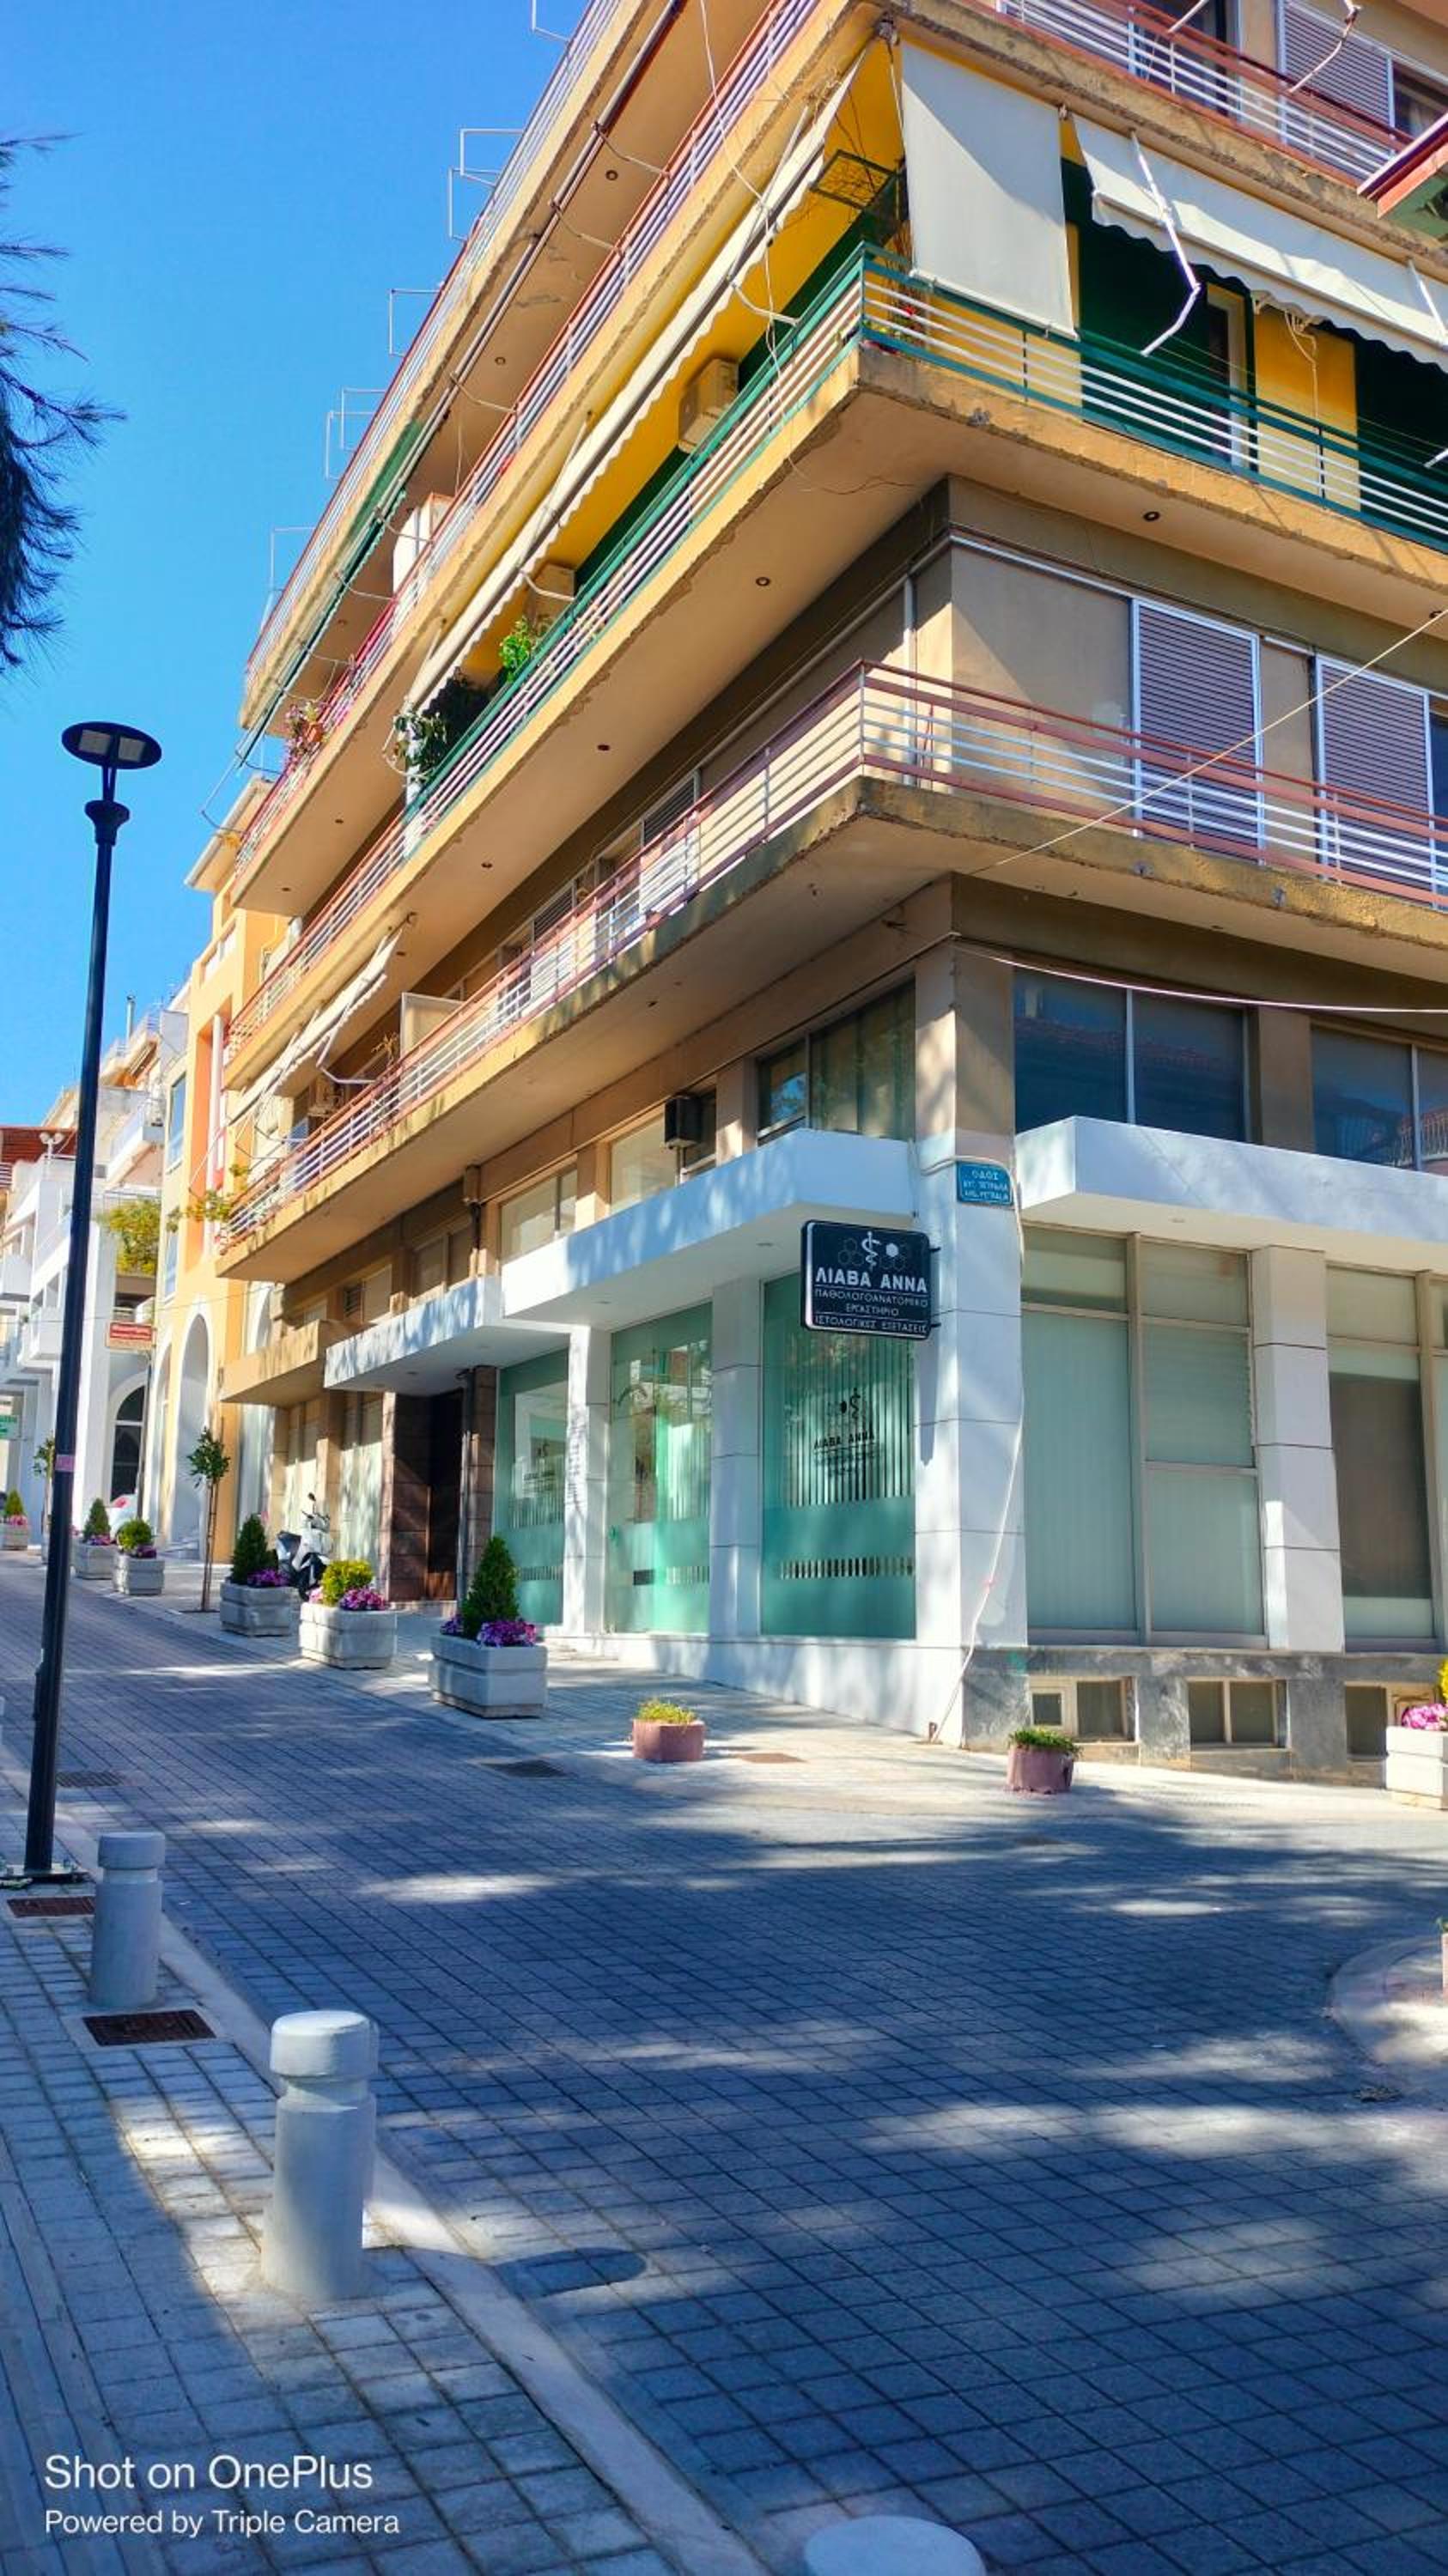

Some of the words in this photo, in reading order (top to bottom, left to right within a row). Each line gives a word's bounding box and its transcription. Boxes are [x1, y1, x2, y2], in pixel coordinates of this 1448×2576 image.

[971, 1170, 999, 1181] ΟΔΟΣ
[815, 1267, 872, 1287] ΛΙΑΒΑ
[880, 1273, 928, 1292] ΑΝΝΑ
[846, 1303, 899, 1316] ΕΡΓΑΣΤΗΡΙΟ
[815, 1315, 876, 1329] ΙΣΤΟΛΟΓΙΚΕΣ
[881, 1322, 928, 1334] ΕΞΕΤΑΣΕΙΣ
